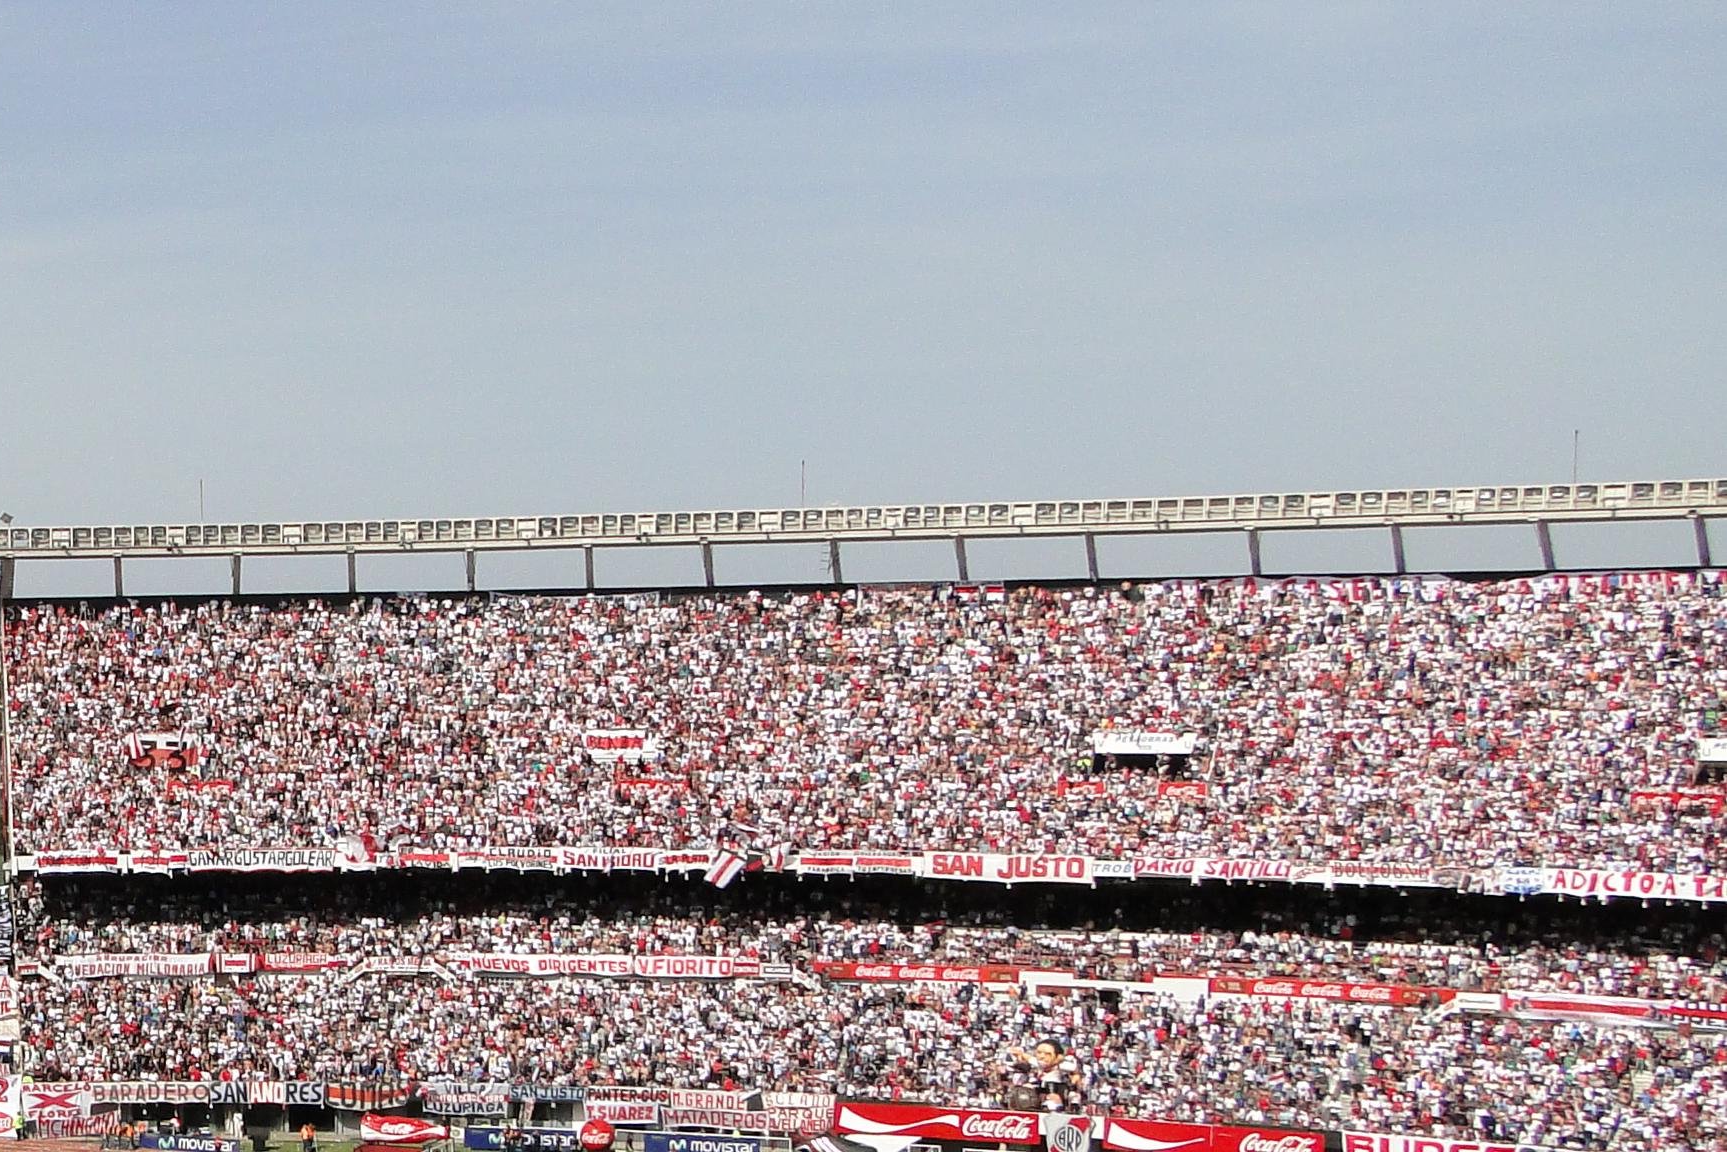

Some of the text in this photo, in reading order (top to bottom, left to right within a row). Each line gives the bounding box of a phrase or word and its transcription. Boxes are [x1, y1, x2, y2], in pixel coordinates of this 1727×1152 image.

[489, 848, 551, 858] CLAUDIO
[563, 850, 598, 868] SAN
[932, 854, 1086, 879] SAN JUSTO
[1133, 857, 1195, 874] DARIO
[1552, 869, 1654, 895] ADICTO
[473, 957, 530, 973] NUEVOS
[538, 957, 628, 974] DIRIGENTES
[93, 1083, 209, 1101] BARADERO
[511, 1086, 584, 1100] SAN JUSTO
[425, 1102, 505, 1114] LUZURIAGA
[768, 1108, 834, 1119] PARQUE
[663, 1111, 766, 1130] MATADEROS
[962, 1113, 1035, 1140] Coca-Cola
[178, 1137, 237, 1152] movistar
